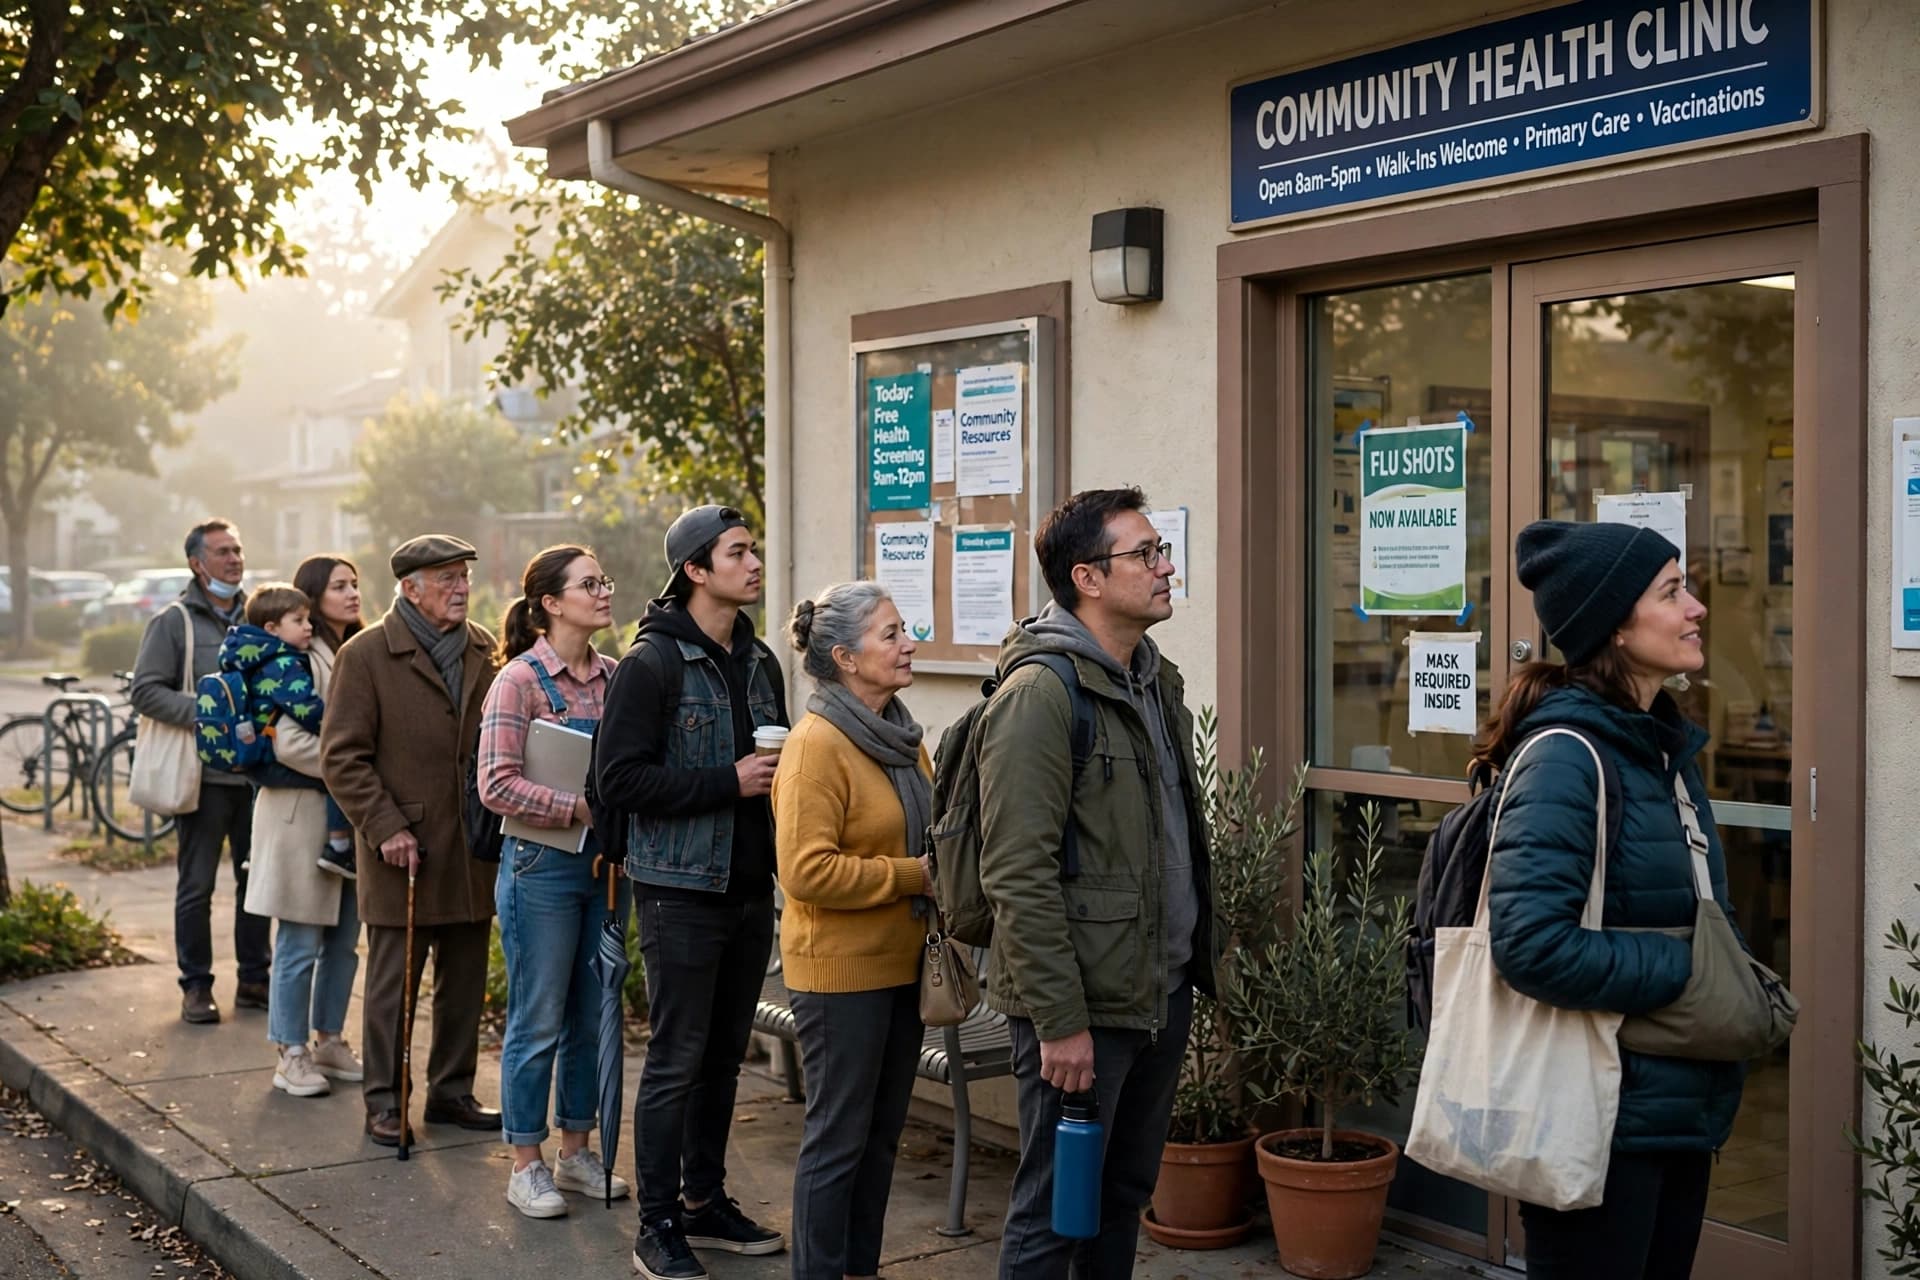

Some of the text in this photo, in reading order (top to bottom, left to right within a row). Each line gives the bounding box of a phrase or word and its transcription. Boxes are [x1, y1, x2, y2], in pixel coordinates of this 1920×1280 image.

[1256, 0, 1769, 150] COMMUNITY HEALTH CLINIC
[1259, 178, 1292, 204] Open
[1376, 149, 1437, 178] Walk-Ins
[1439, 137, 1508, 166] Welcome
[1525, 121, 1588, 150] Primary
[1591, 112, 1630, 138] Care
[1650, 85, 1765, 126] Vaccinations
[875, 383, 914, 404] Today:
[874, 408, 899, 424] Free
[960, 408, 1016, 427] Community
[874, 425, 910, 444] Health
[961, 429, 1011, 444] Resources
[873, 445, 925, 466] Screening
[1370, 445, 1455, 477] FLU SHOTS
[1369, 508, 1457, 529] NOW AVAILABLE
[880, 532, 929, 547] Community
[881, 549, 925, 560] Resources
[1426, 653, 1459, 669] MASK
[1415, 672, 1471, 689] REQUIRED
[1424, 692, 1461, 710] INSIDE
